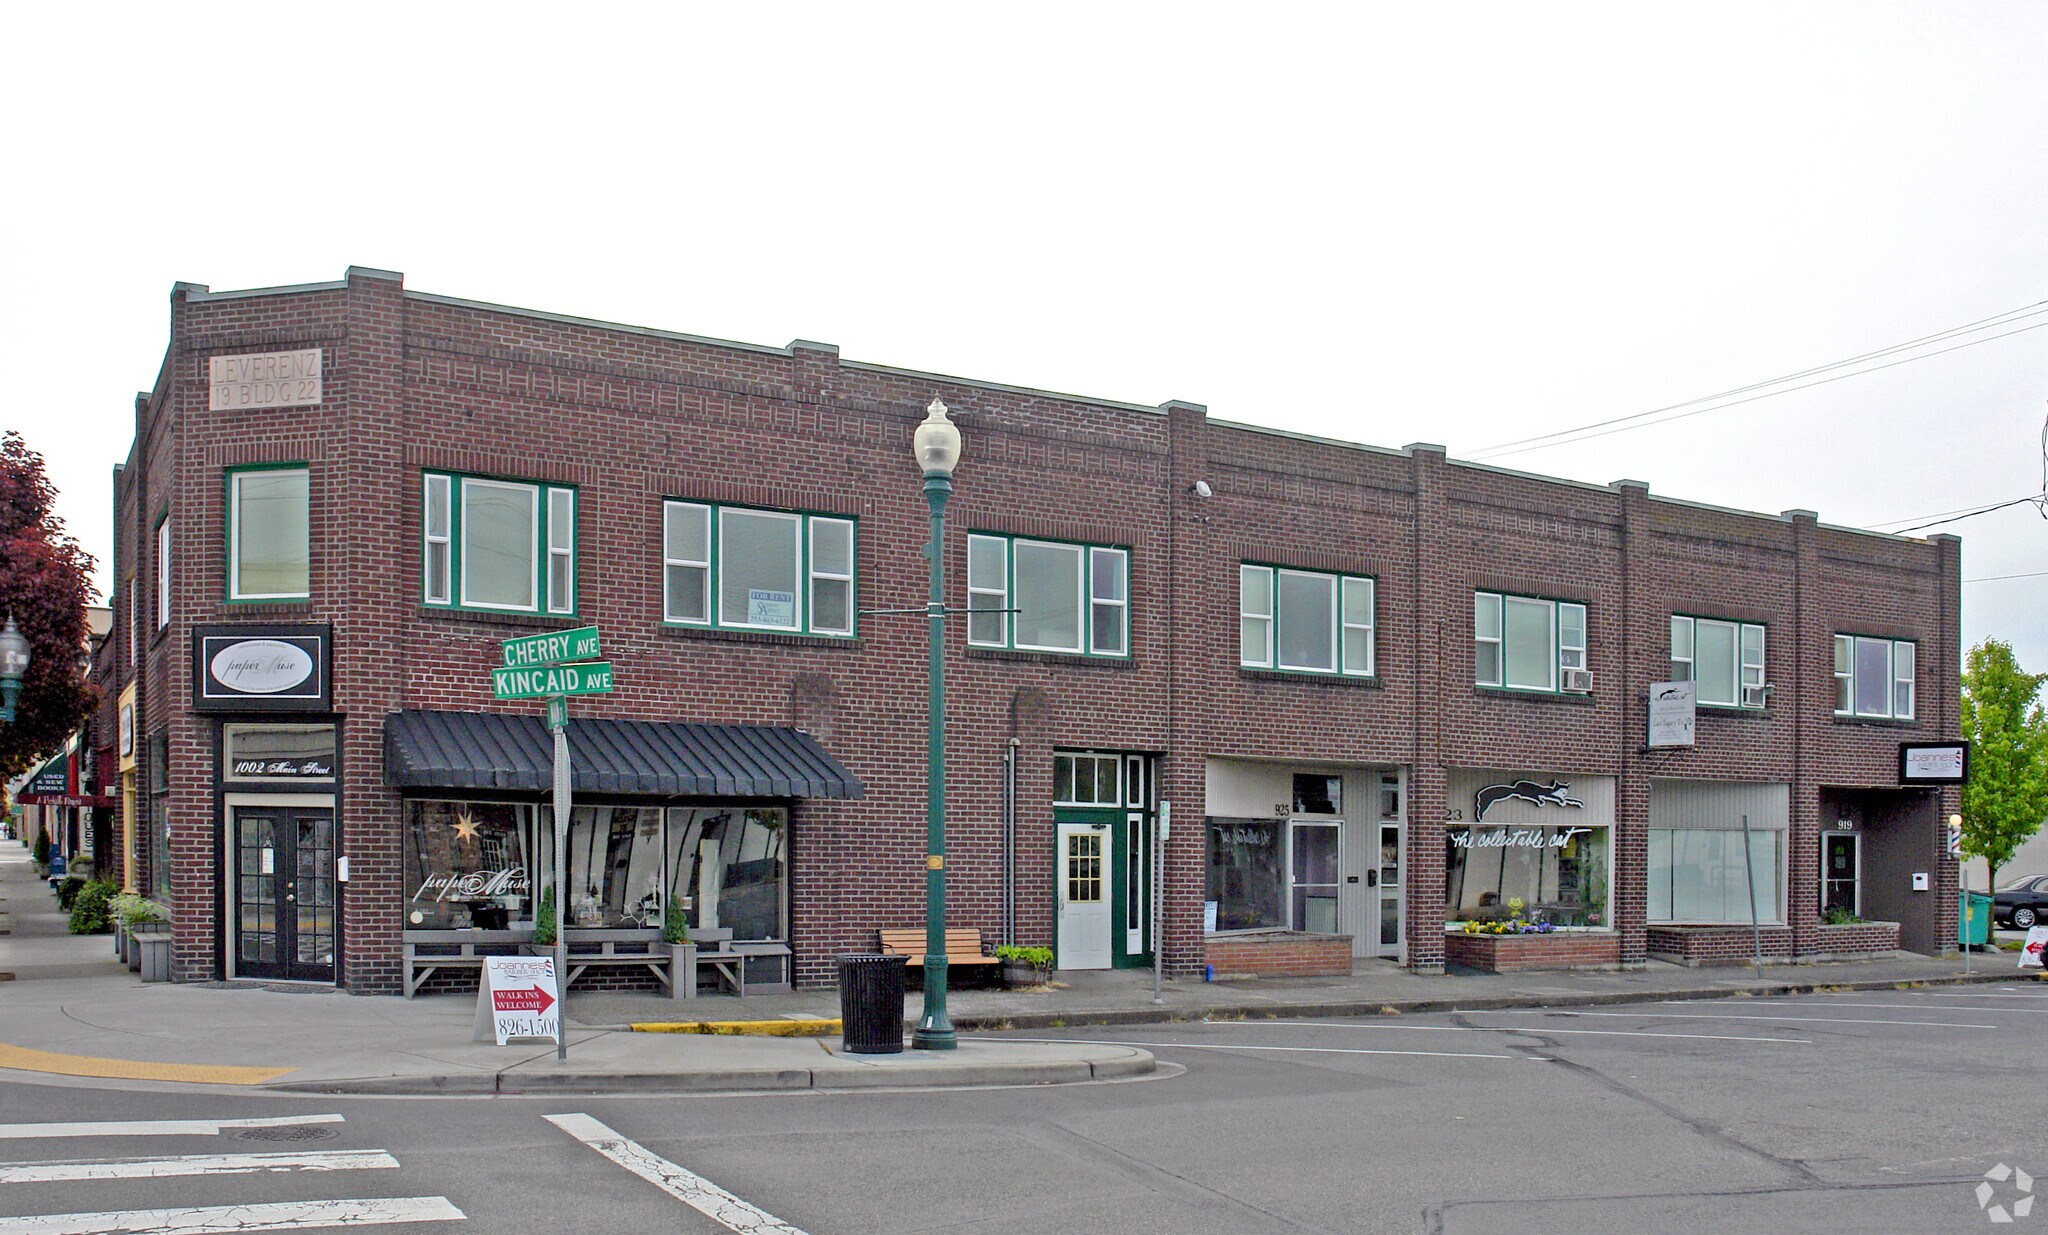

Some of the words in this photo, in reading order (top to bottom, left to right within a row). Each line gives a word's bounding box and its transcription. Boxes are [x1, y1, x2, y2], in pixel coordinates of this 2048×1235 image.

[214, 352, 317, 384] LEVERENZ
[215, 386, 231, 407] 19
[240, 382, 291, 405] BLDG
[298, 380, 316, 400] 22
[752, 592, 768, 600] FOR
[770, 594, 791, 602] RENT
[505, 635, 569, 667] CHERRY
[576, 638, 597, 656] AVE
[496, 668, 579, 695] KINCAID
[586, 672, 611, 689] AVE
[234, 761, 265, 774] 1002
[267, 761, 298, 775] Main
[300, 761, 330, 775] Street
[1275, 804, 1289, 816] 925
[1837, 819, 1853, 830] 919
[1477, 829, 1545, 848] collectable
[1548, 827, 1592, 848] cat
[497, 991, 523, 999] WALK
[525, 991, 539, 999] INS
[497, 1001, 542, 1009] WELCOME
